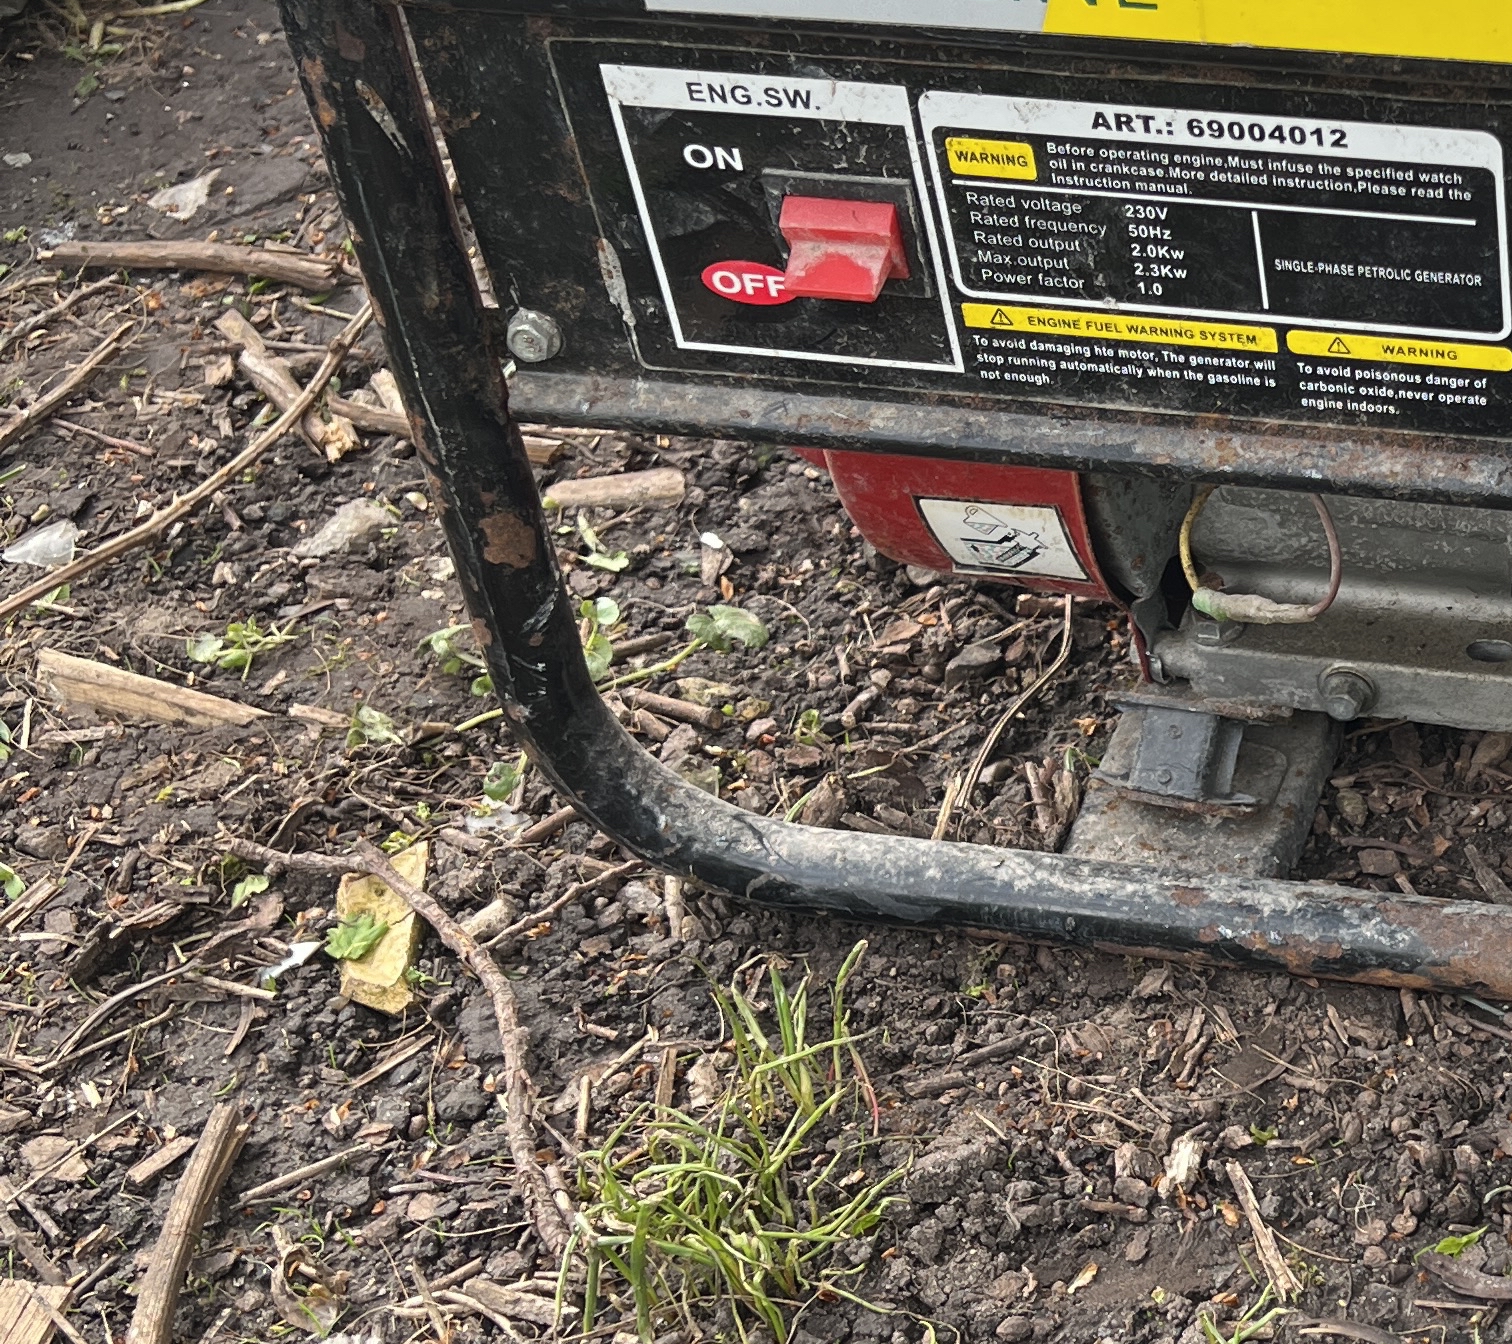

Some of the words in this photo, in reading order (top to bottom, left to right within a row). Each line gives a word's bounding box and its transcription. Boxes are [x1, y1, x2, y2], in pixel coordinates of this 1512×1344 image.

[685, 81, 822, 110] ENG.SW.
[1091, 111, 1174, 136] ART.:
[1186, 118, 1349, 149] 69004012
[683, 144, 743, 172] ON
[954, 150, 1029, 167] WARNING
[1046, 142, 1094, 157] Before
[1099, 147, 1169, 165] operating
[1267, 159, 1313, 173] infuse
[1318, 163, 1341, 176] the
[1346, 166, 1414, 181] specified
[1418, 171, 1463, 185] watch
[1049, 159, 1067, 170] oil
[1072, 159, 1085, 171] in
[1209, 170, 1268, 186] detailed
[1411, 186, 1444, 200] read
[1448, 189, 1472, 201] the
[1136, 182, 1193, 195] manual.
[966, 192, 1016, 208] Rated
[1021, 197, 1083, 216] voltage
[1125, 204, 1168, 221] 230V
[970, 211, 1019, 228] Rated
[1024, 216, 1107, 239] frequency
[1128, 224, 1172, 240] 50Hz
[973, 230, 1023, 247] Rated
[1028, 237, 1081, 253] output
[1131, 244, 1185, 261] 2.0Kw
[712, 270, 786, 298] OFF
[981, 268, 1033, 285] Power
[1038, 273, 1085, 289] factor
[1137, 281, 1163, 296] 1.0
[1134, 263, 1188, 280] 2.3Kw
[1274, 258, 1355, 277] SINGLE-PHASE
[1358, 265, 1412, 281] PETROLIC
[1414, 270, 1483, 287] GENERATOR
[1027, 316, 1081, 330] ENGINE
[1085, 321, 1122, 333] FUEL
[1126, 324, 1195, 339] WARNING
[1199, 330, 1257, 345] SYSTEM
[972, 334, 989, 346] To
[992, 337, 1026, 350] avoid
[1029, 340, 1091, 357] damaging
[1161, 350, 1185, 363] The
[1189, 354, 1250, 369] generator
[1253, 359, 1276, 371] will
[1381, 344, 1458, 360] WARNING
[976, 352, 1004, 365] stop
[1007, 356, 1057, 371] running
[1059, 359, 1143, 378] automatically
[1147, 367, 1180, 379] when
[1184, 369, 1204, 381] the
[1207, 373, 1261, 386] gasoline
[1264, 375, 1276, 387] is
[980, 369, 1001, 381] not
[1004, 371, 1055, 386] enough.
[1296, 361, 1313, 374] To
[1316, 365, 1351, 378] avoid
[1355, 368, 1422, 384] poisonous
[1425, 374, 1470, 389] danger
[1473, 377, 1487, 389] of
[1299, 380, 1355, 395] carbonic
[1437, 392, 1487, 406] operate
[1301, 397, 1343, 411] engine
[1346, 399, 1400, 415] indoors.
